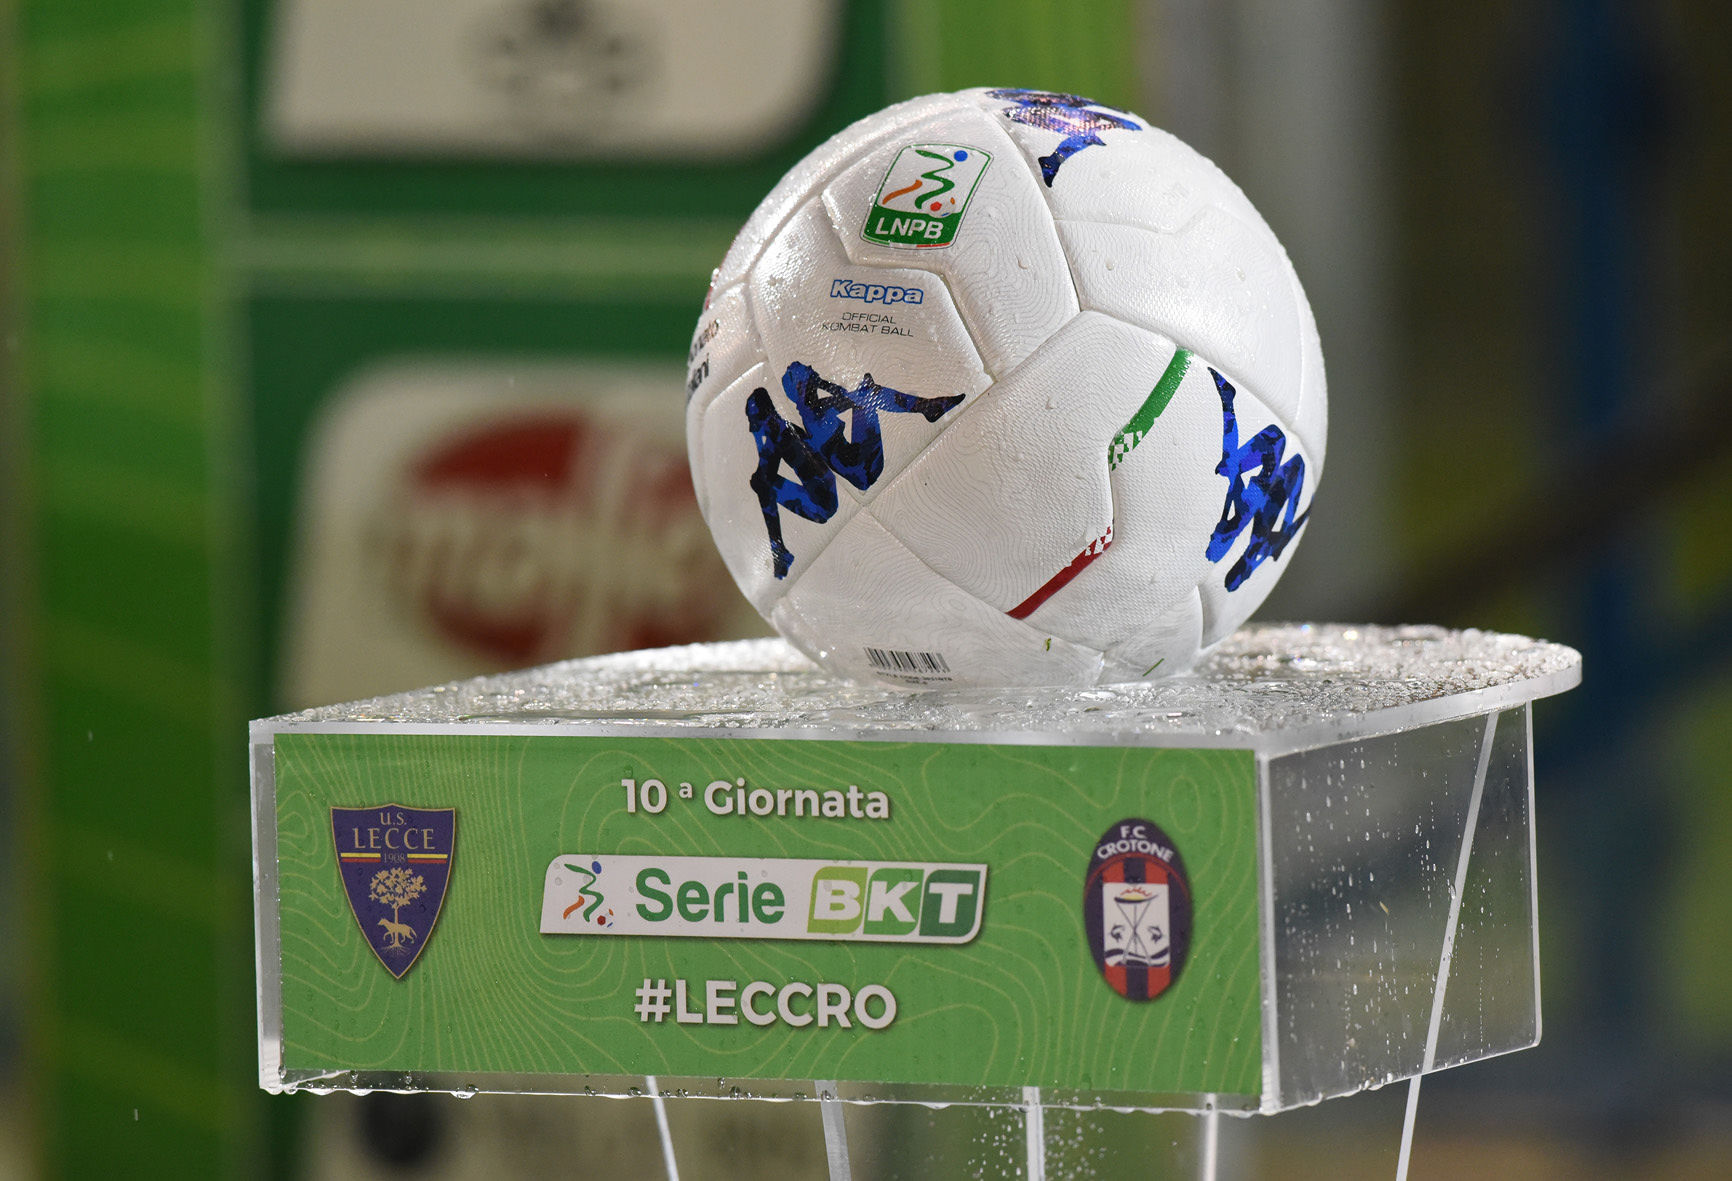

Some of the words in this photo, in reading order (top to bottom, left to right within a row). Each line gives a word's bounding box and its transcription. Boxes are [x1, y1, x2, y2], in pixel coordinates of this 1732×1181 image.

[875, 217, 944, 239] LNPB
[830, 279, 924, 304] Kappa
[822, 322, 877, 333] KOMBAT
[842, 312, 896, 325] OFFICIAL
[881, 327, 914, 337] BALL
[621, 779, 667, 813] 10
[705, 778, 890, 819] Giornata
[352, 828, 436, 850] LECCE
[383, 852, 406, 864] 1908
[1097, 839, 1174, 863] CROTONE
[635, 868, 785, 924] Serie
[811, 880, 974, 924] BKT
[634, 979, 897, 1029] #LECCRO
